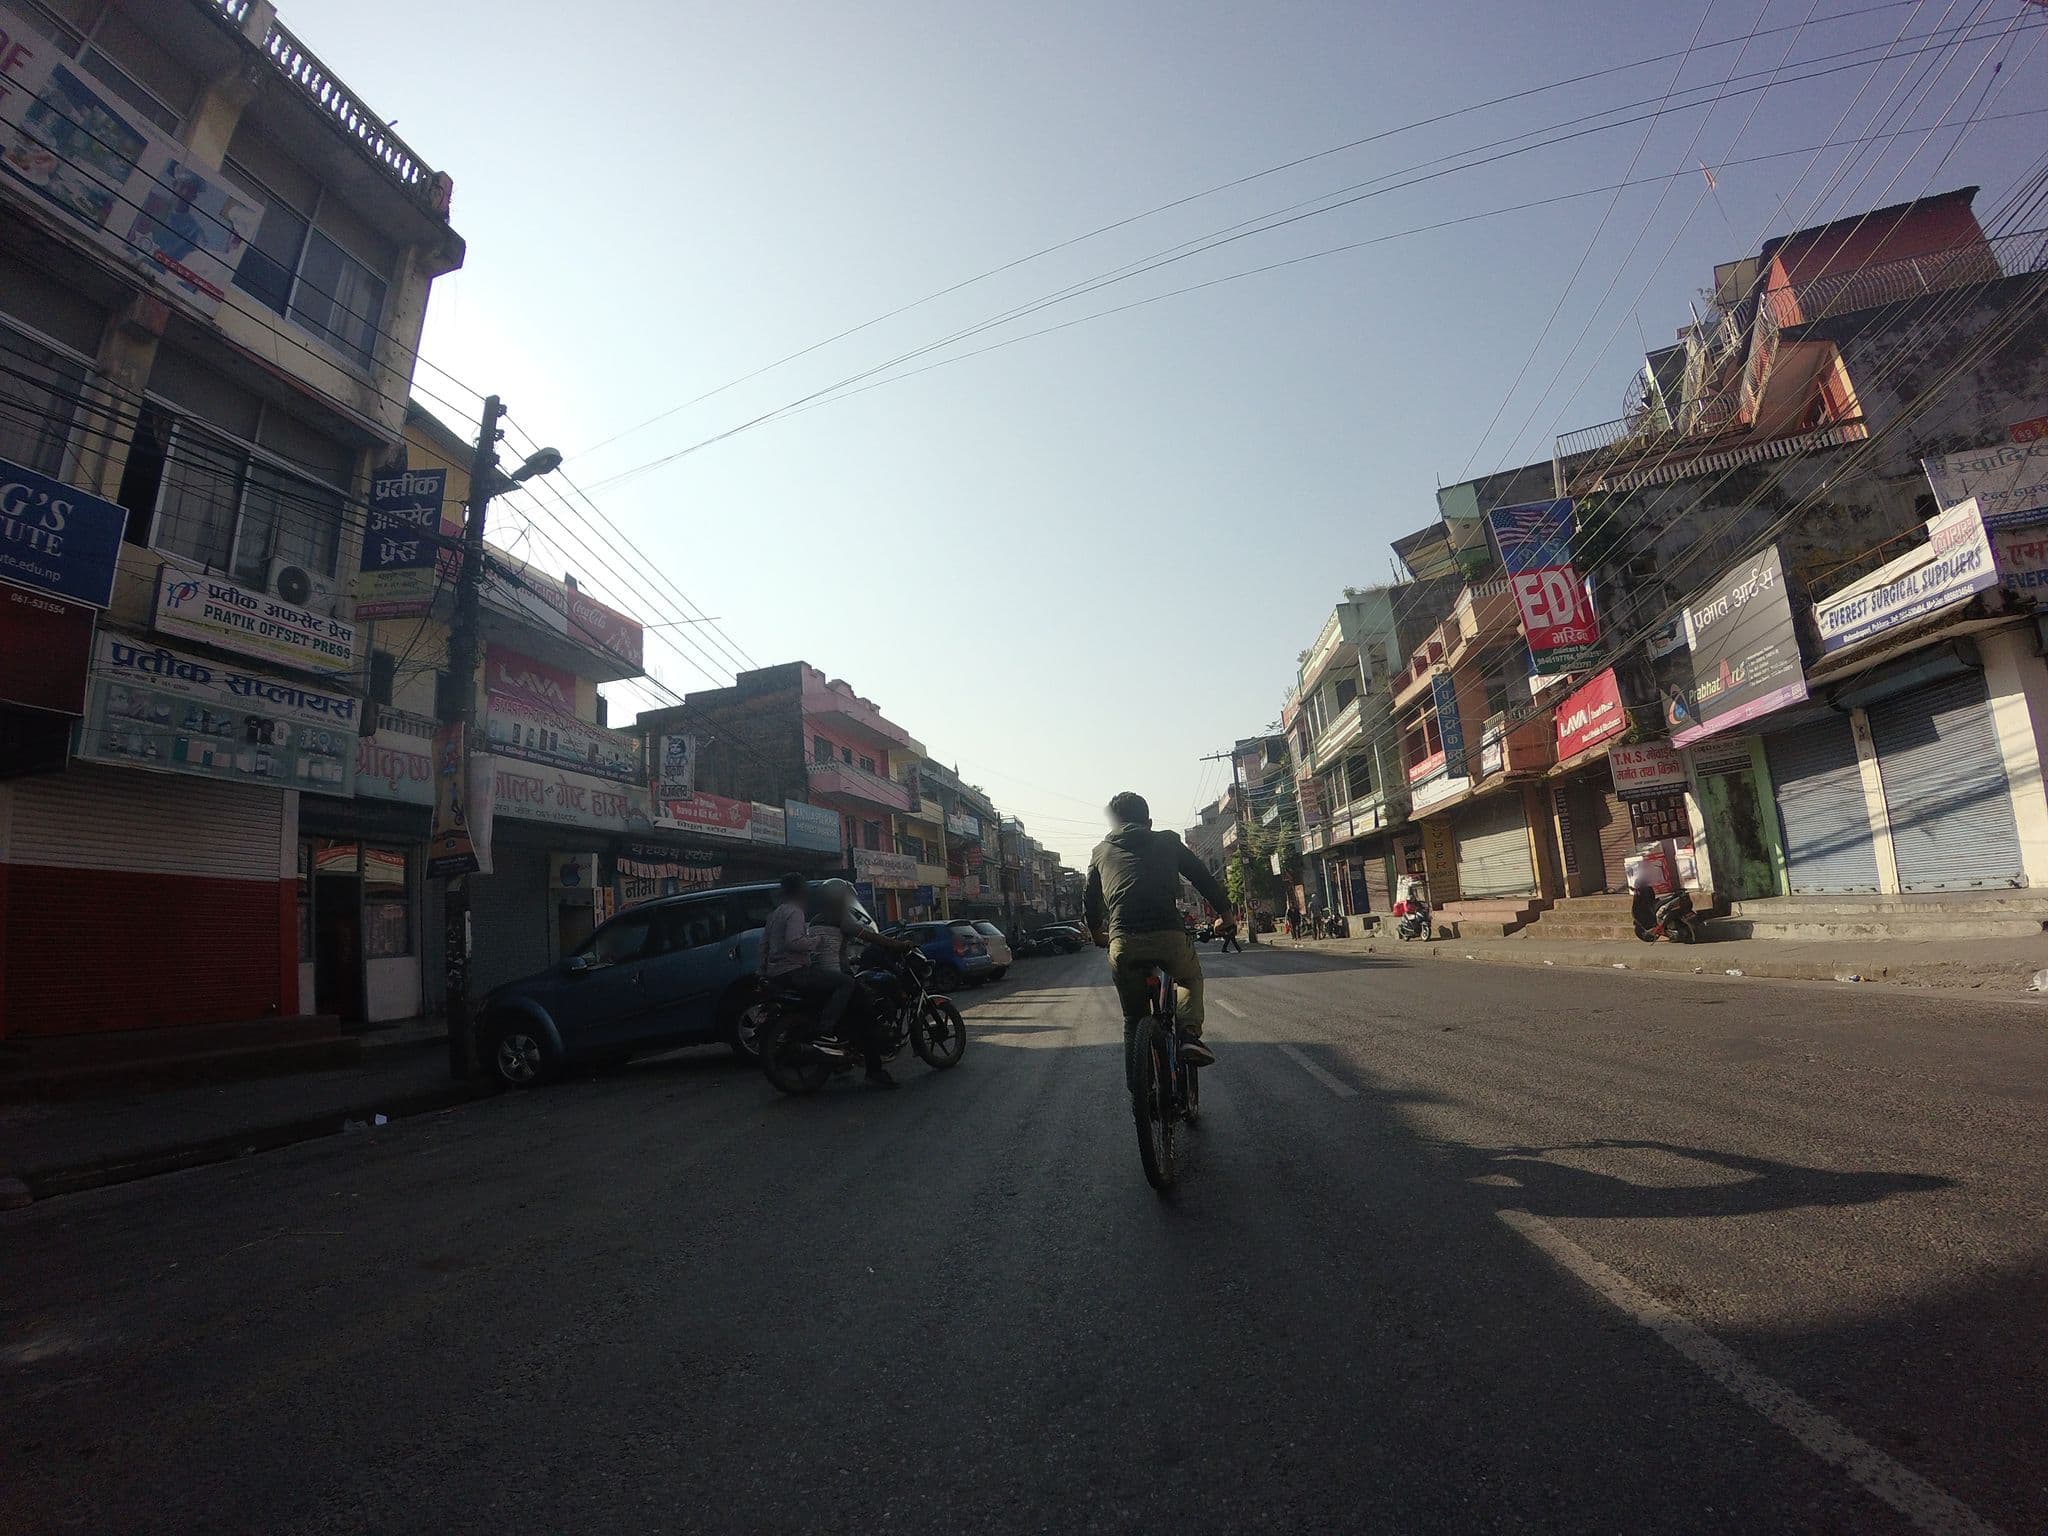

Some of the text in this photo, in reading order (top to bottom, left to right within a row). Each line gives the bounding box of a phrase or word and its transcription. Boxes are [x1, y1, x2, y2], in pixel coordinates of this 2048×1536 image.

[0, 476, 74, 531] G'S
[377, 472, 441, 501] प्रतीक
[207, 584, 260, 611] प्रतीक
[264, 602, 324, 632] अफसेट
[327, 621, 353, 643] प्रेस
[1693, 596, 1729, 633] प्रभात
[1828, 598, 1868, 630] EVEREST
[1871, 576, 1920, 612] SURGICAL
[1922, 545, 1982, 595] SUPPLIERS
[204, 604, 257, 632] PRATIK
[259, 624, 311, 648] OFFSET
[311, 638, 352, 661] PRESS
[111, 641, 214, 686] प्रतीक
[223, 671, 358, 722] सप्लायर्स
[1559, 708, 1588, 738] LAVA
[1613, 750, 1646, 766] T.N.S.
